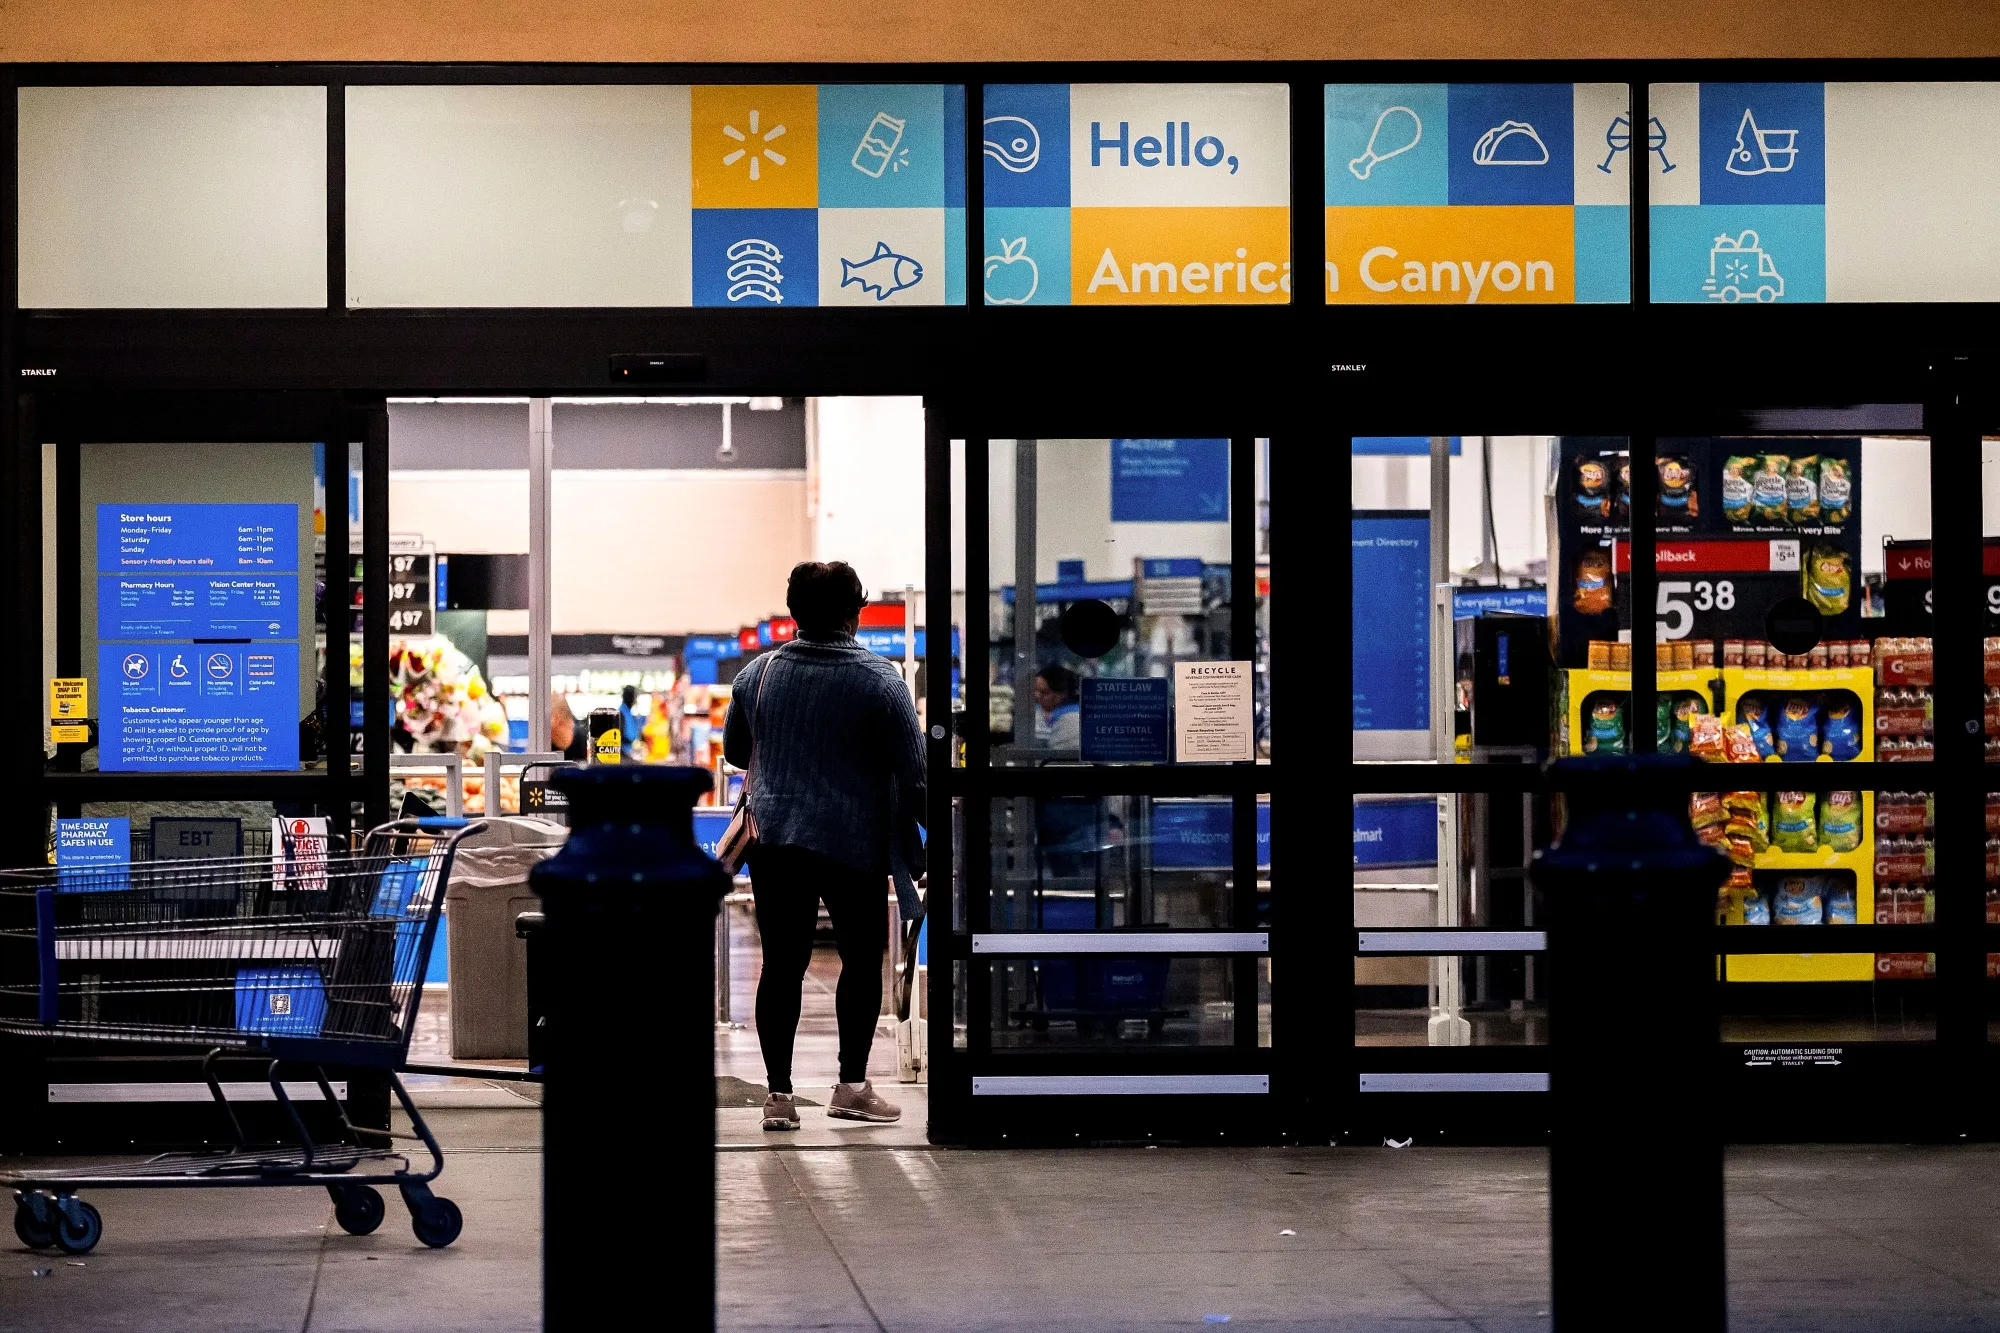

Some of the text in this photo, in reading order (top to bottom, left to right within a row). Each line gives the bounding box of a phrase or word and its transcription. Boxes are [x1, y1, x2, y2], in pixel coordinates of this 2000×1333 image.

[1090, 121, 1239, 175] Hello,
[1360, 246, 1555, 304] Canyon
[120, 514, 172, 522] Store hours
[1580, 526, 1602, 535] More
[1825, 526, 1841, 535] Bite
[1377, 537, 1419, 548] Directory
[121, 546, 145, 554] Sunday
[121, 558, 176, 566] Sensory-friendly
[198, 558, 214, 566] daily
[121, 582, 153, 590] Pharmacy
[1454, 596, 1525, 610] Everyday Low
[1891, 659, 1904, 673] G
[1096, 683, 1152, 692] STATE LAW
[179, 718, 202, 726] appear
[204, 717, 233, 726] younger
[1876, 715, 1889, 730] G
[134, 726, 146, 734] will
[147, 726, 156, 734] be
[158, 726, 177, 734] asked
[189, 726, 215, 735] provide
[216, 726, 236, 735] proof
[247, 727, 259, 735] age
[260, 726, 270, 735] by
[1096, 726, 1153, 734] LEY ESTATAL
[123, 736, 151, 744] showing
[194, 746, 218, 754] proper
[123, 755, 158, 763] permitted
[168, 755, 200, 763] purchase
[231, 755, 263, 763] products.
[1876, 813, 1889, 828] G
[61, 822, 109, 830] TIME-DELAY
[180, 831, 214, 846] EBT
[1180, 830, 1230, 844] Welcome
[61, 839, 86, 847] SAFES
[1875, 862, 1889, 877] G
[1878, 958, 1891, 973] G
